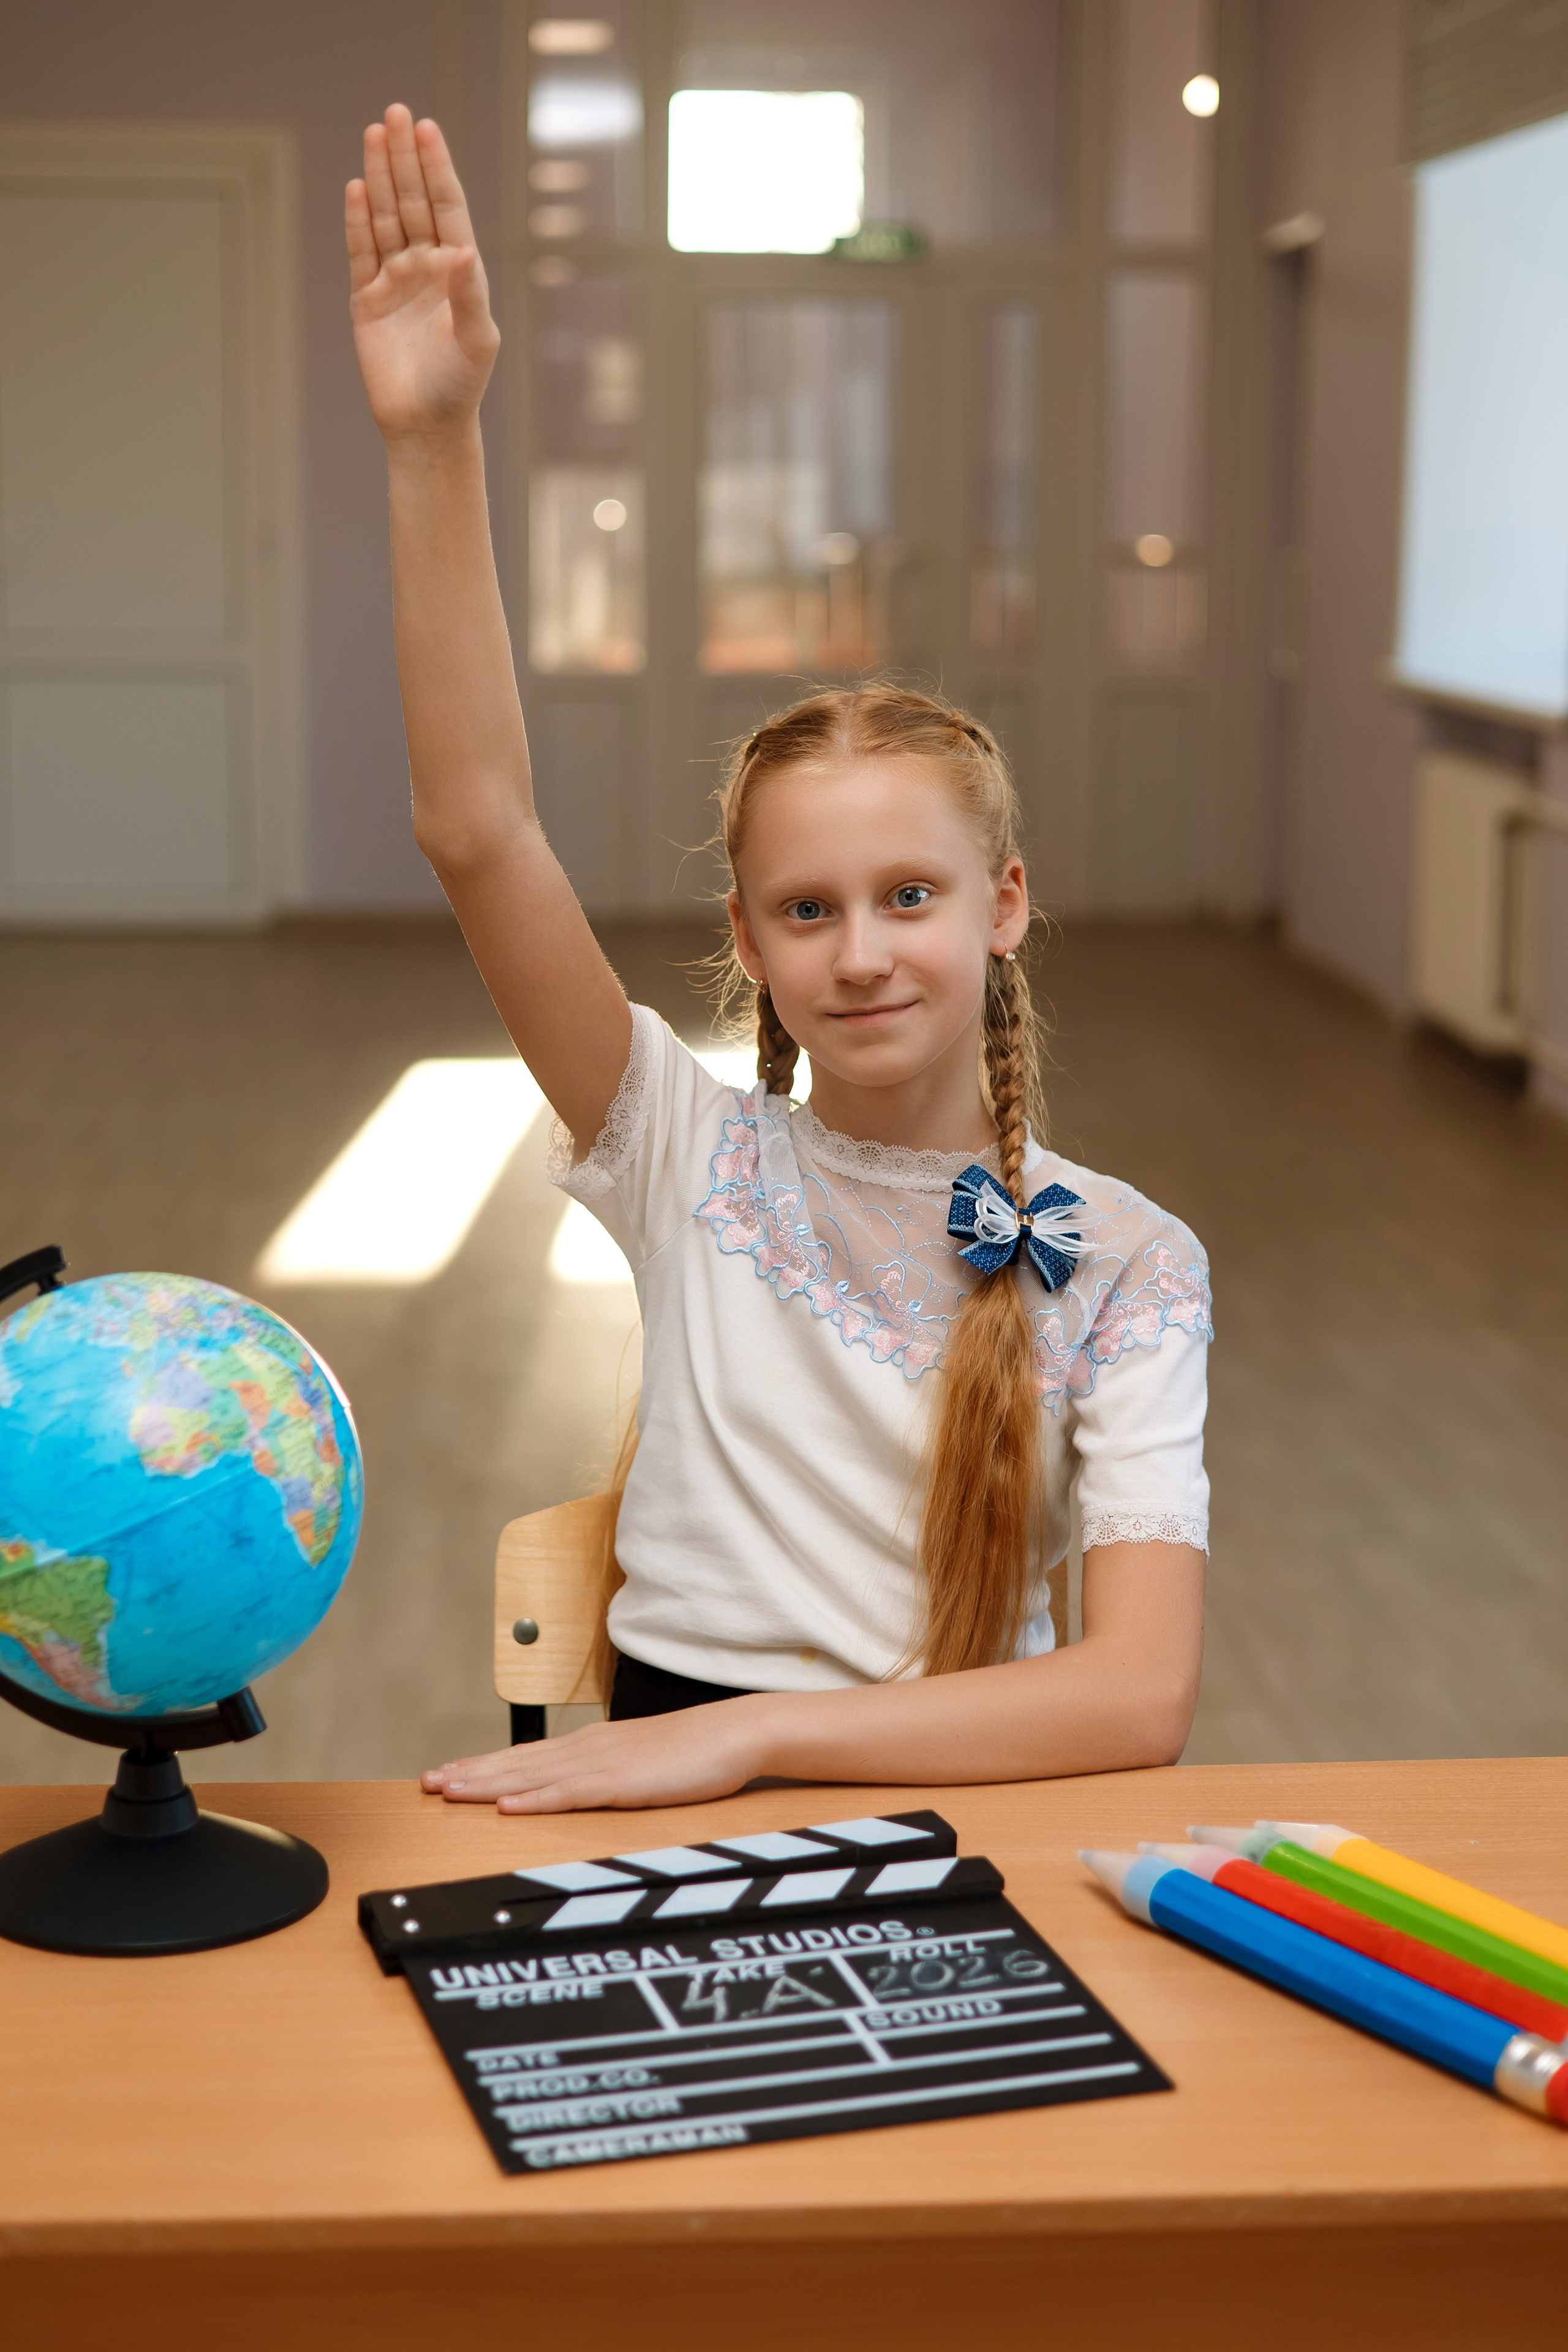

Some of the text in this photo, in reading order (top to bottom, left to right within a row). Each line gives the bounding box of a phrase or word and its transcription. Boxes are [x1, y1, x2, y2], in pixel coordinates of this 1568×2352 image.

[889, 1939, 987, 1963] ROLL
[430, 1944, 698, 1991] UNIVERSAL
[687, 1961, 786, 1984] TAKE
[867, 1949, 1050, 1999] 2026
[476, 1980, 605, 2010] SCENE
[865, 1998, 1003, 2029] SOUND
[475, 2050, 560, 2073] DATE
[505, 2095, 683, 2133] DIRECTOR
[522, 2124, 750, 2168] CAMERAMAN
